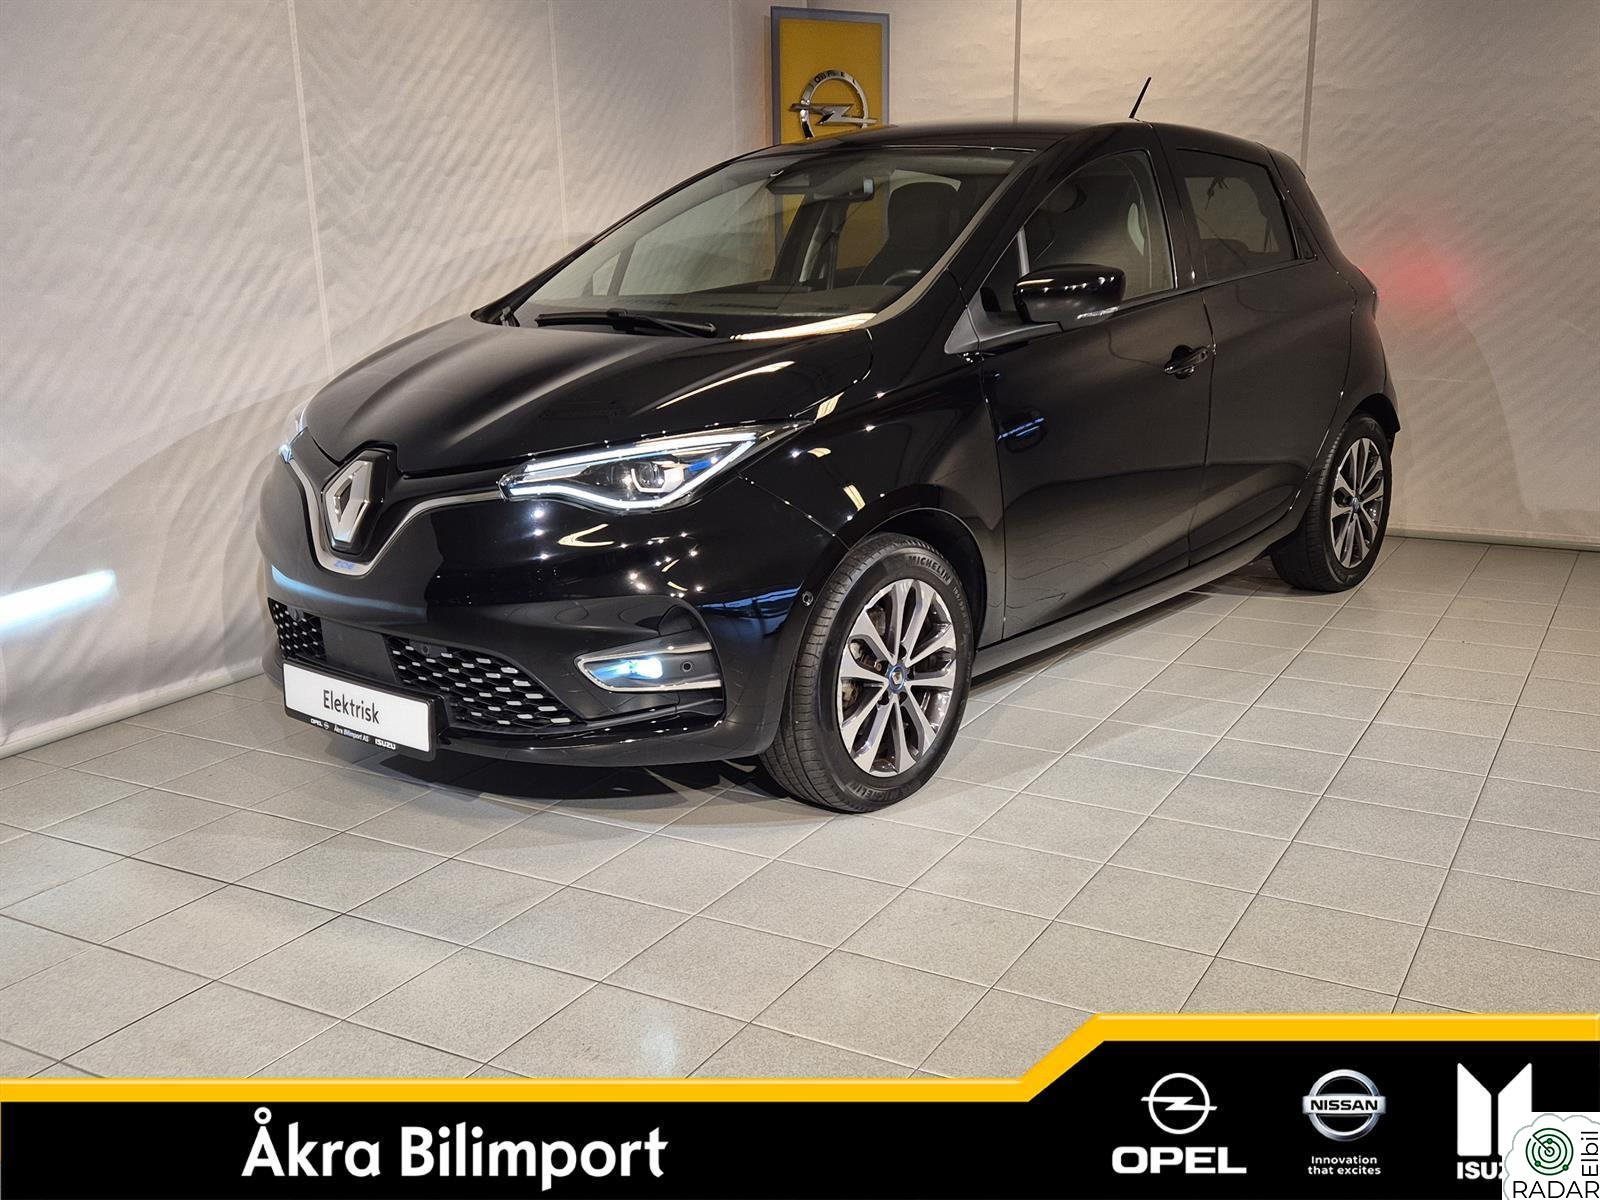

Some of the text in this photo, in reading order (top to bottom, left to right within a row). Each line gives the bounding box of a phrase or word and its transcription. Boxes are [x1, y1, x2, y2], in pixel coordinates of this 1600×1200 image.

[908, 555, 951, 584] MICHELIN
[323, 690, 380, 724] Elektrisk
[310, 718, 323, 727] OPEL
[375, 738, 396, 750] ISUZU
